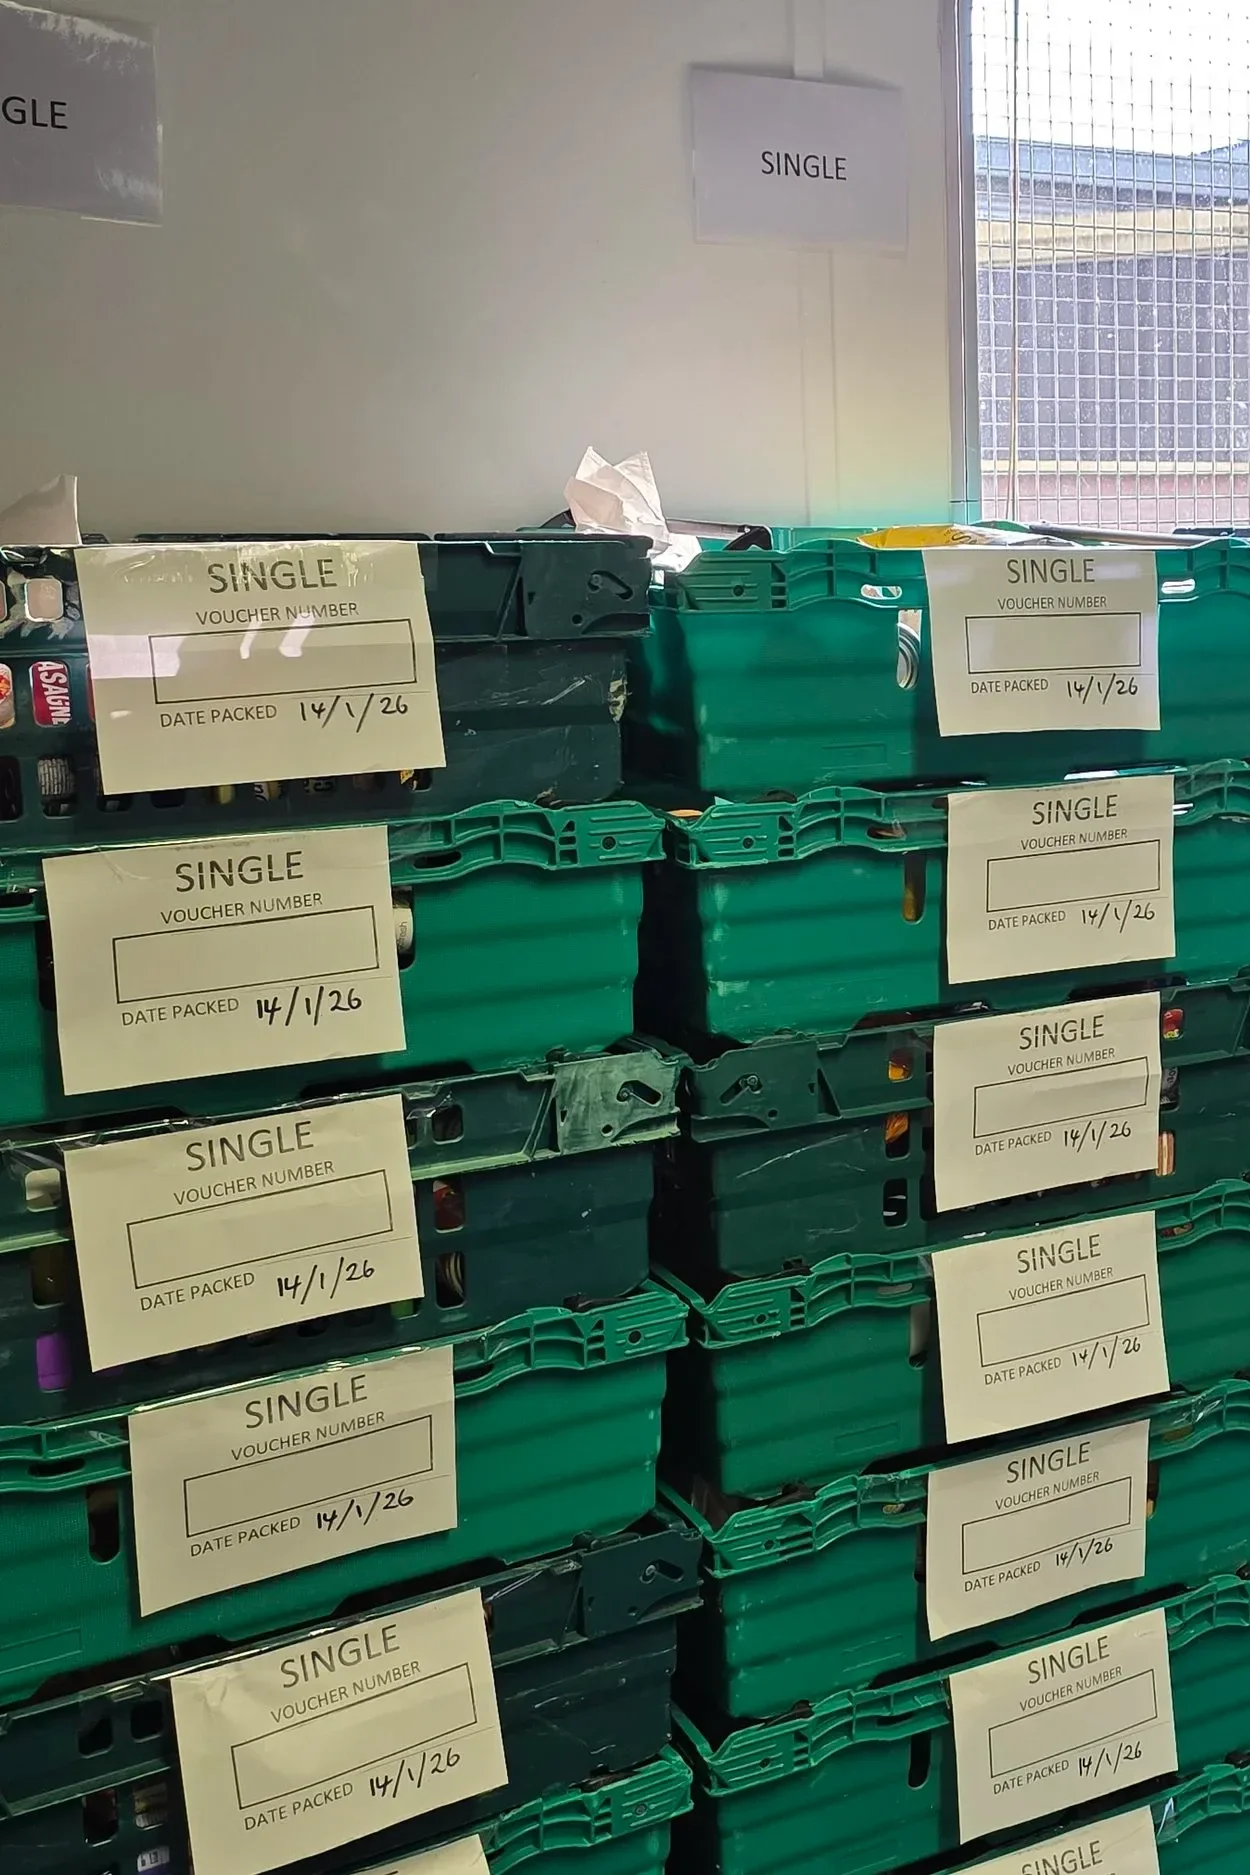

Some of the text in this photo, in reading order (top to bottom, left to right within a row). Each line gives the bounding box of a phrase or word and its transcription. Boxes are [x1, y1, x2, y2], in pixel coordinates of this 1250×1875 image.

[2, 96, 68, 129] GLE
[761, 151, 847, 180] SINGLE
[208, 558, 337, 593] SINGLE
[1007, 558, 1095, 584] SINGLE
[196, 602, 357, 625] VOUCHER NUMBER
[998, 596, 1106, 610] VOUCHER NUMBER
[971, 673, 1138, 704] DATE PACKED 14/1/26
[160, 693, 408, 732] DATE PACKED 14/1/26
[1032, 795, 1117, 825] SINGLE
[1021, 828, 1127, 850] VOUCHER NUMBER
[176, 851, 303, 892] SINGLE
[160, 893, 321, 924] VOUCHER NUMBER
[988, 899, 1155, 933] DATE PACKED 14/1/26
[122, 986, 362, 1026] DATE PACKED 14/1/26
[1020, 1015, 1104, 1050] SINGLE
[1008, 1048, 1114, 1076] VOUCHER NUMBER
[186, 1121, 314, 1171] SINGLE
[975, 1120, 1131, 1155] DATE PACKED 14/1/26
[174, 1161, 334, 1205] VOUCHER NUMBER
[1017, 1234, 1101, 1274] SINGLE
[140, 1257, 375, 1311] DATE PACKED 14/1/26
[1009, 1267, 1113, 1300] VOUCHER NUMBER
[984, 1337, 1141, 1385] DATE PACKED 14/1/26
[246, 1374, 367, 1428] SINGLE
[231, 1411, 384, 1461] VOUCHER NUMBER
[1007, 1441, 1090, 1483] SINGLE
[996, 1471, 1099, 1510] VOUCHER NUMBER
[191, 1489, 414, 1557] DATE PACKED 14/1/26
[965, 1537, 1113, 1592] DATE PACKED 14/1/26
[281, 1624, 400, 1688] SINGLE
[1028, 1635, 1109, 1684] SINGLE
[271, 1661, 420, 1723] VOUCHER NUMBER
[1020, 1666, 1122, 1711] VOUCHER NUMBER
[993, 1741, 1142, 1795] DATE PACKED 14/1/26
[245, 1748, 460, 1830] DATE PACKED 14/1/26
[1021, 1840, 1104, 1875] SINGLE
